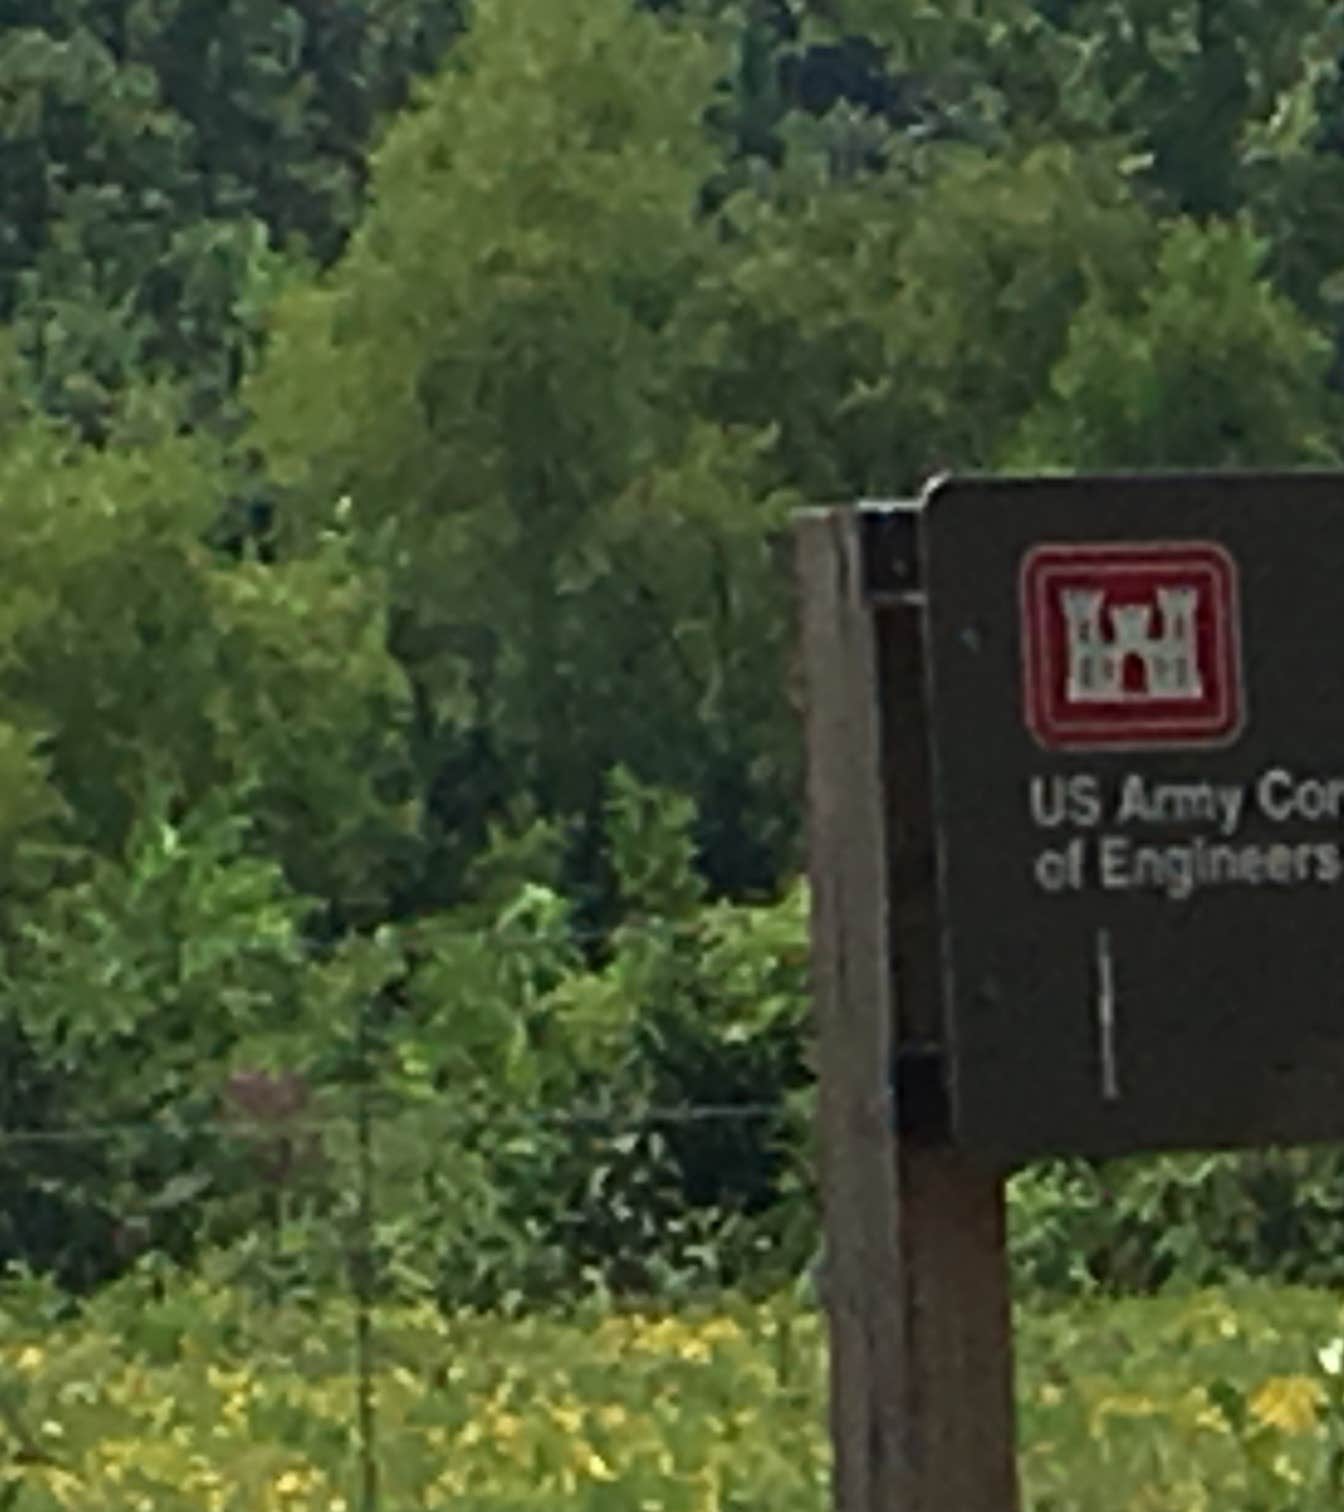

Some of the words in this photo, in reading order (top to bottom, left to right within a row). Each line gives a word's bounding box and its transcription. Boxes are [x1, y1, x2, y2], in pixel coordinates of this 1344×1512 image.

[1029, 776, 1102, 827] US
[1117, 774, 1243, 835] Army
[1034, 839, 1086, 891] of
[1099, 837, 1343, 900] Engineers
